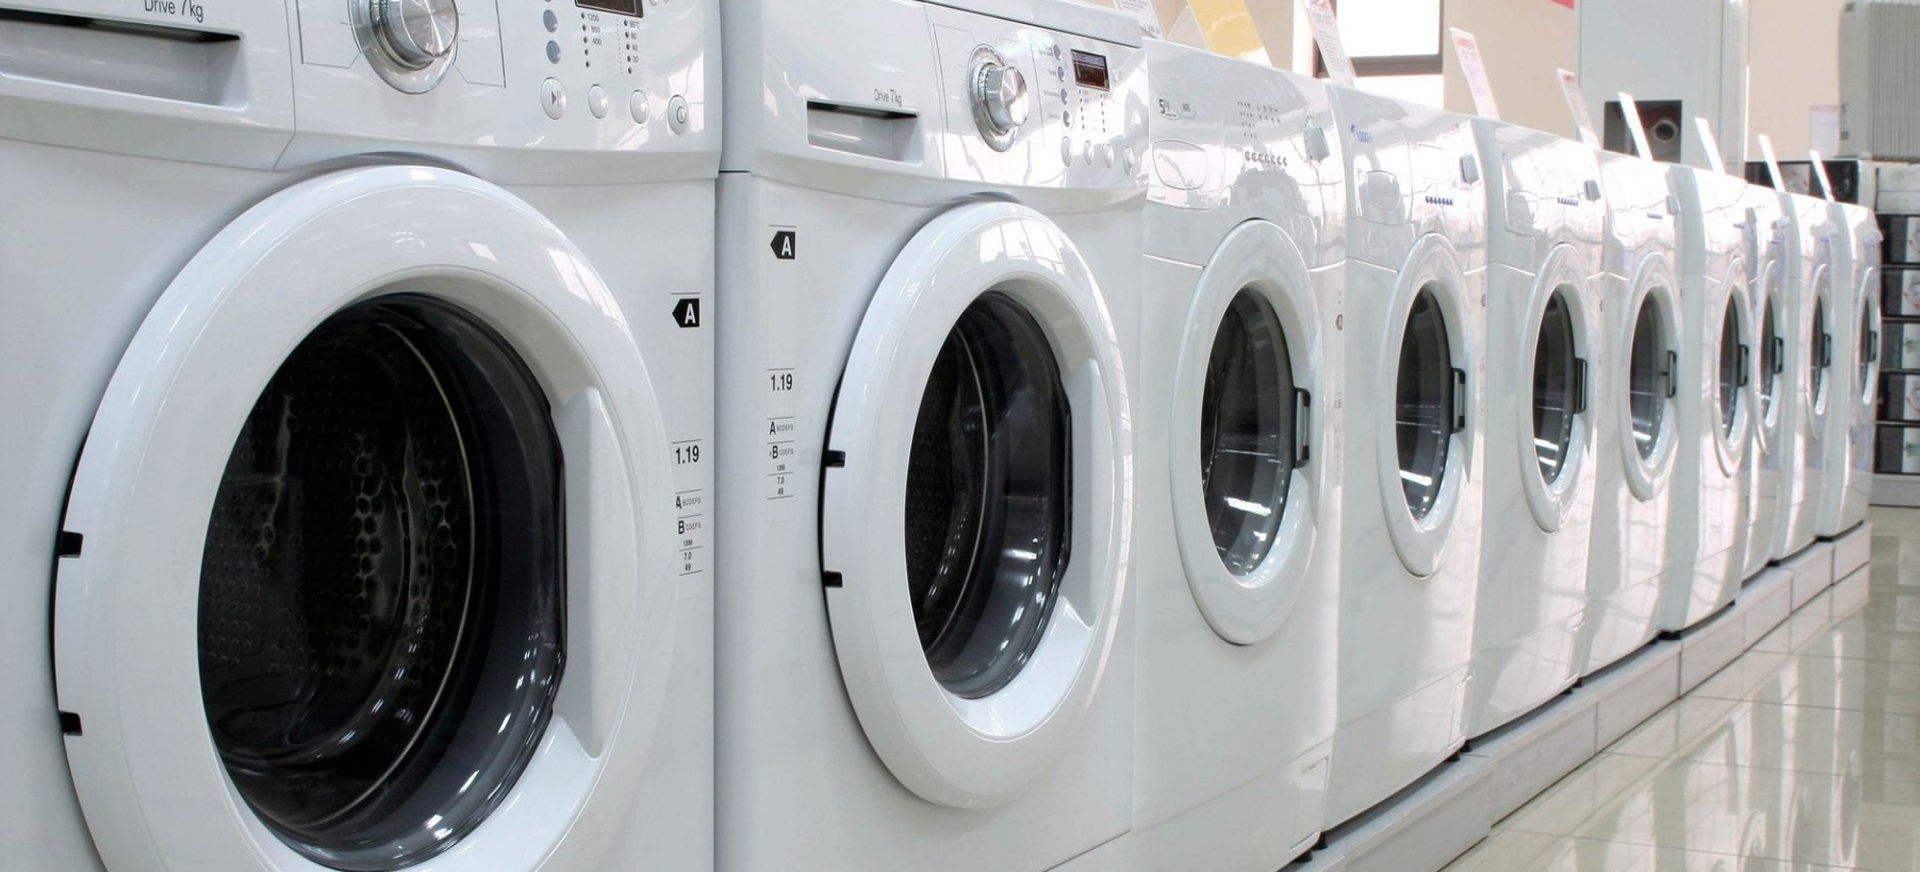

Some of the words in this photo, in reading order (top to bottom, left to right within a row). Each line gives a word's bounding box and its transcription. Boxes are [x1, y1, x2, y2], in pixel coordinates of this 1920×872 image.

[144, 0, 176, 15] Drive
[873, 88, 890, 103] Drive
[781, 235, 792, 257] A
[684, 302, 697, 325] A
[770, 372, 793, 391] 1.19
[675, 444, 700, 465] 1.19
